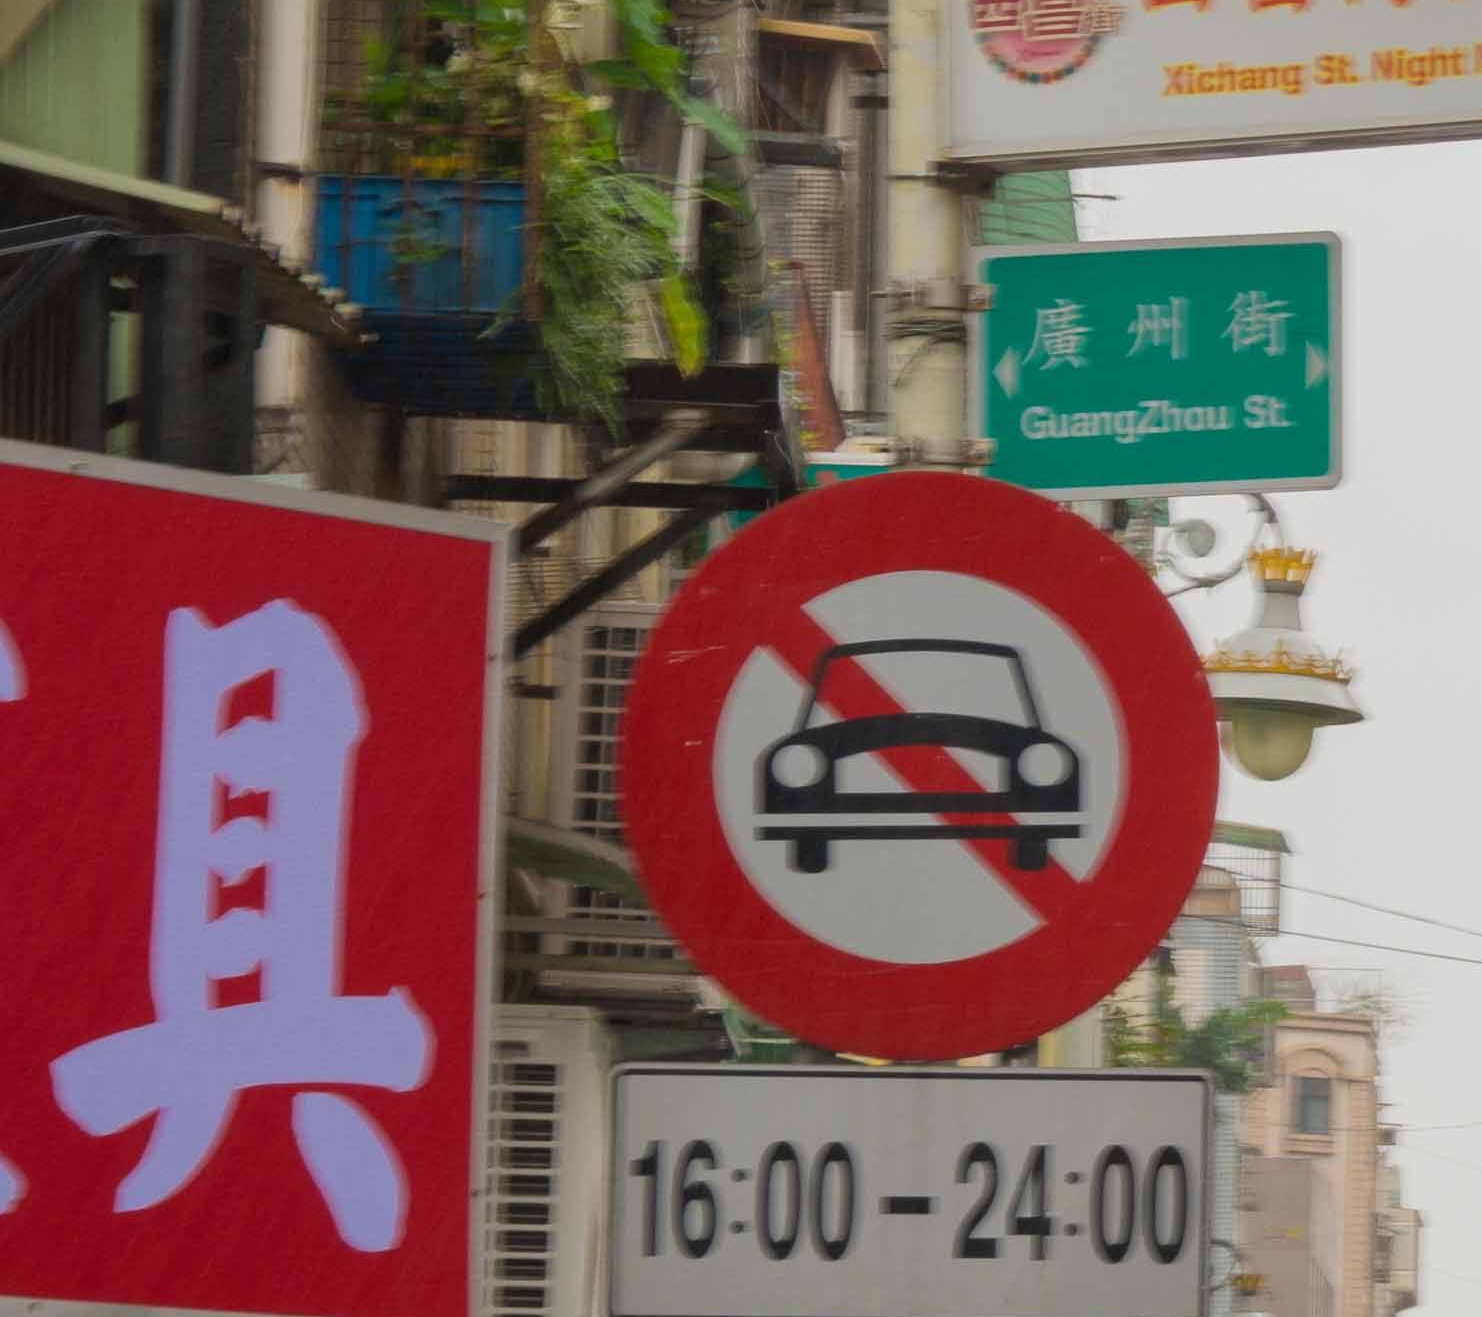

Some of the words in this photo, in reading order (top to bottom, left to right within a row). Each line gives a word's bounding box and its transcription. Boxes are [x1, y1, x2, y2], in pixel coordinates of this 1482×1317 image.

[1162, 62, 1304, 97] Xichang
[1313, 54, 1358, 85] St.
[1371, 46, 1464, 87] Night
[1022, 290, 1296, 371] 廣州街
[1019, 399, 1232, 444] GuangZhou
[1243, 394, 1295, 429] St.
[0, 597, 436, 1253] 具
